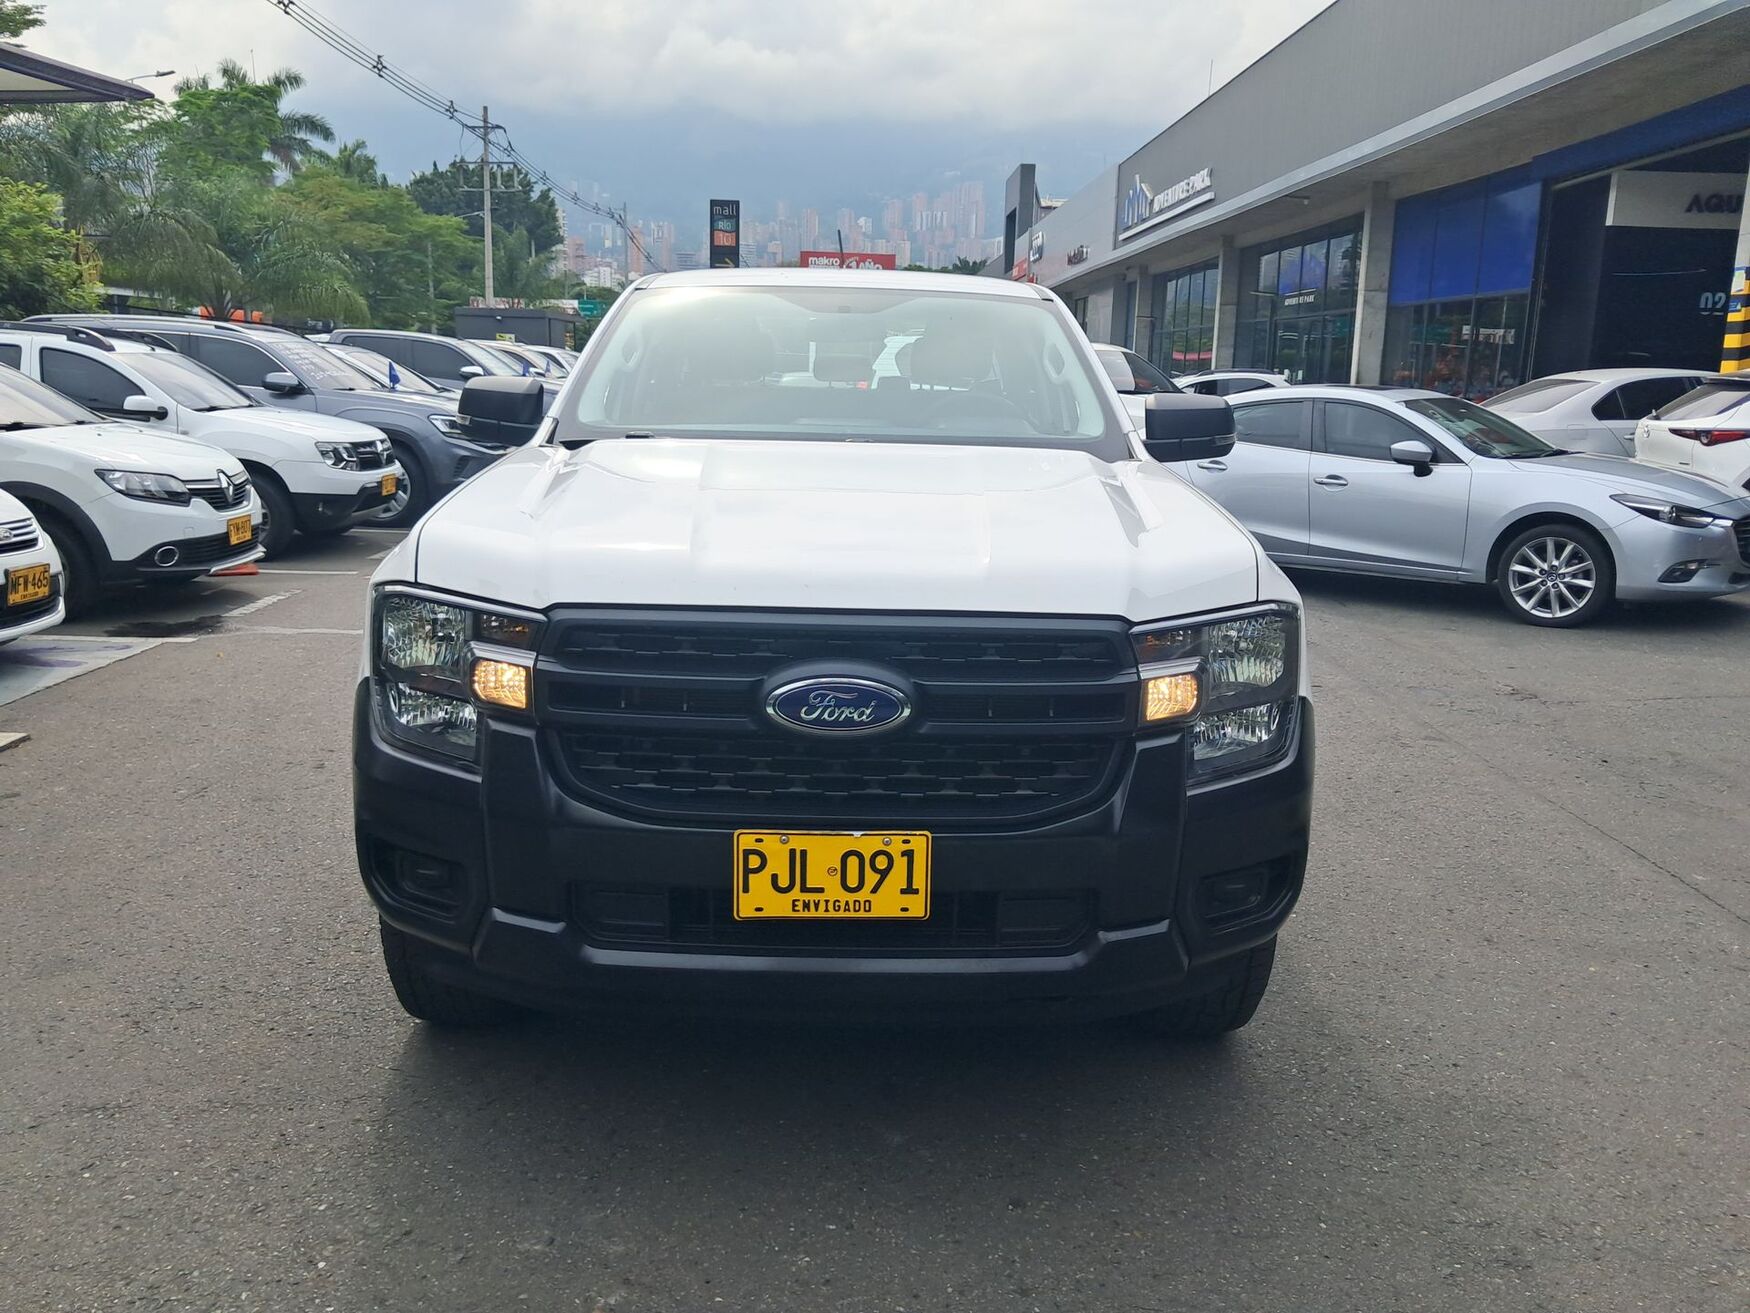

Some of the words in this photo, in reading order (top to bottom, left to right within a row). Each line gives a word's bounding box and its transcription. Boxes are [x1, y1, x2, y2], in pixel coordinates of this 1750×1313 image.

[713, 204, 736, 215] mall
[808, 256, 840, 266] makro
[1699, 292, 1726, 315] 02
[800, 690, 877, 722] Ford
[742, 848, 826, 895] PJL
[839, 849, 920, 896] 091
[791, 898, 872, 913] ENVIGADO
